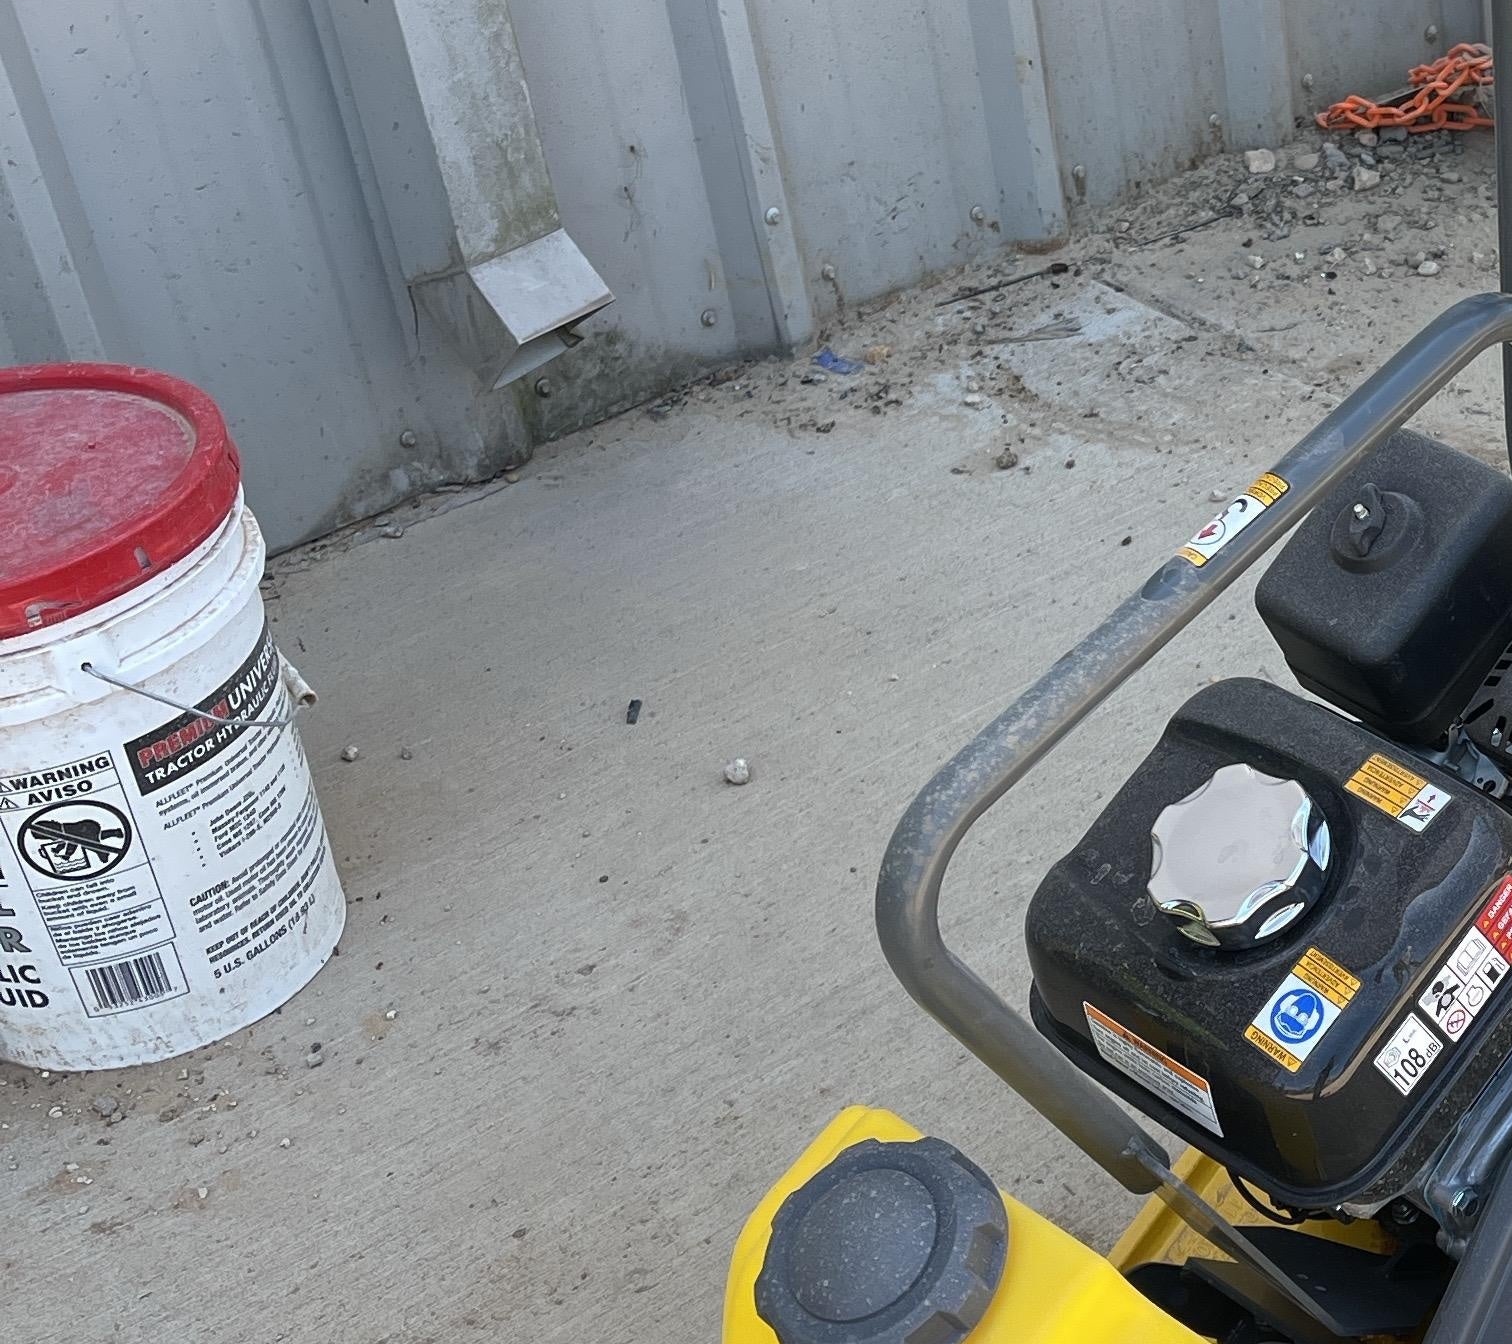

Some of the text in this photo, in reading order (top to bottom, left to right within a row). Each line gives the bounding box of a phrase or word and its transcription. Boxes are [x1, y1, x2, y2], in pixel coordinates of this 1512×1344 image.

[9, 756, 110, 790] WARNING
[145, 738, 215, 784] TRACTOR
[28, 780, 92, 805] AVISO
[214, 969, 222, 979] 5
[224, 957, 245, 974] U.S.
[246, 924, 287, 961] GALLONS
[1251, 1030, 1287, 1061] WARNING
[1394, 1042, 1438, 1086] 108 dB
